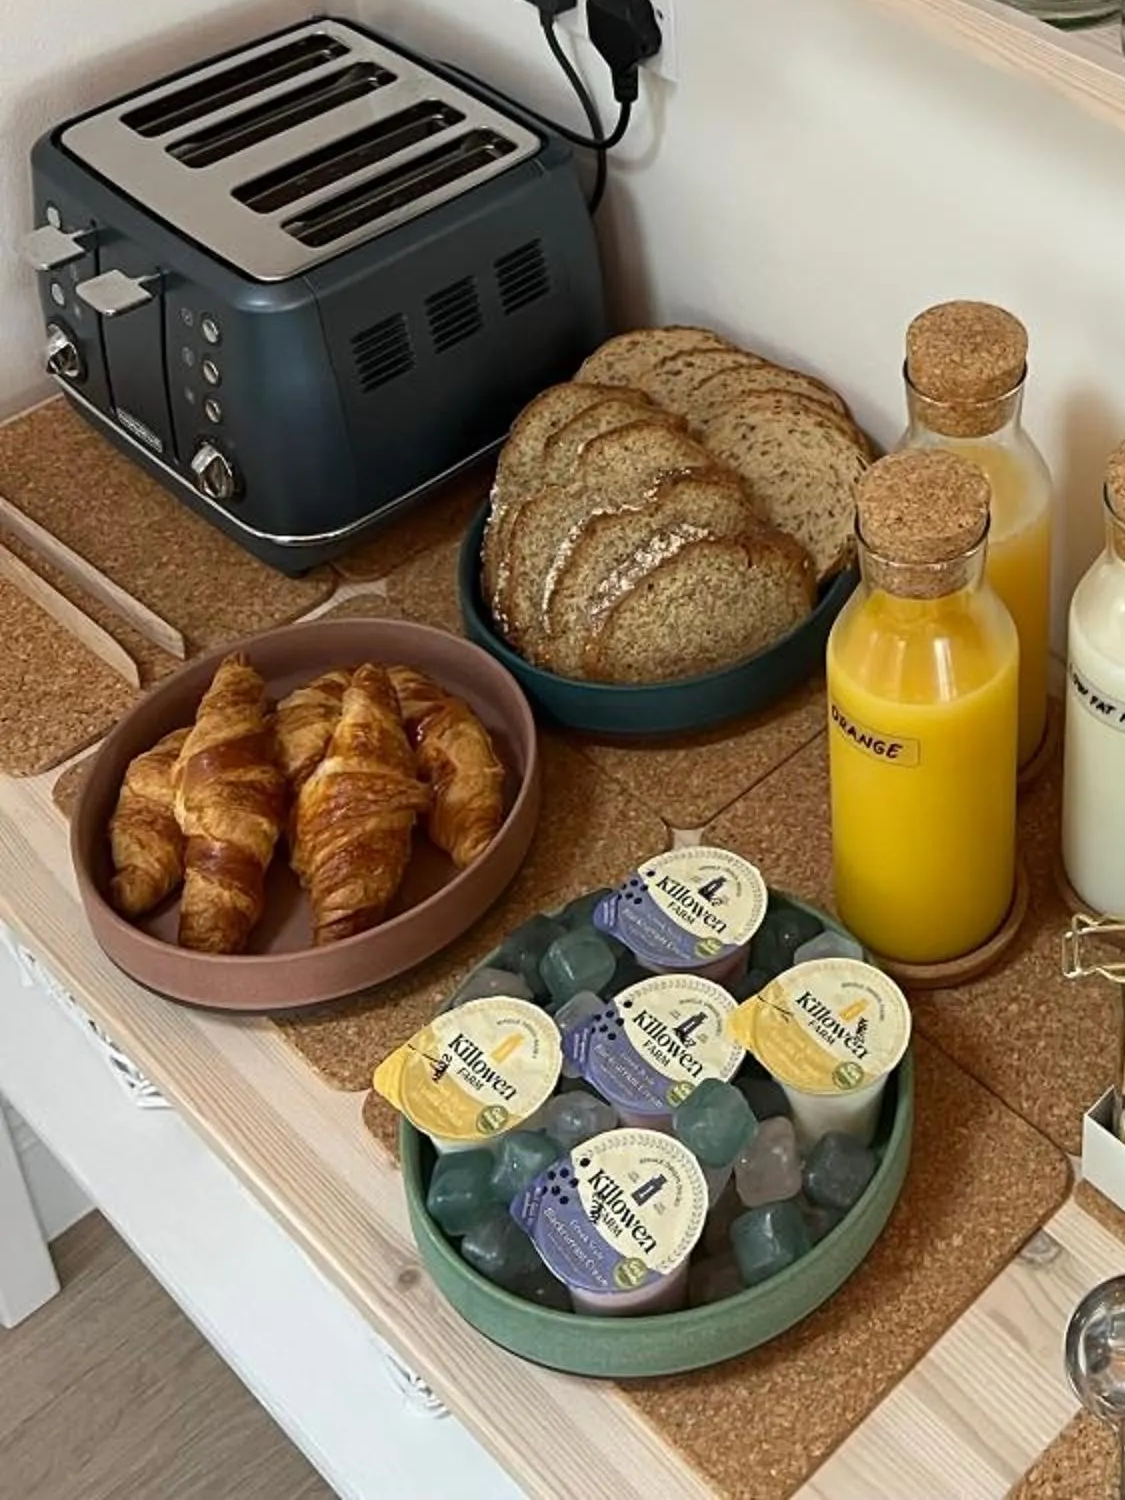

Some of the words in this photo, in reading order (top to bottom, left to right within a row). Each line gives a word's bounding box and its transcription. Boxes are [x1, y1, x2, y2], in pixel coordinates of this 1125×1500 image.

[831, 705, 903, 759] ORANGE
[1090, 695, 1116, 715] FAT
[655, 875, 727, 934] Killowen
[667, 900, 696, 926] FARM
[633, 1009, 704, 1078] Killowen
[795, 991, 870, 1061] Killowen
[807, 1019, 837, 1047] FARM
[447, 1033, 518, 1102] Killowen
[456, 1066, 487, 1093] FARM
[642, 1039, 671, 1068] FARM
[587, 1168, 657, 1255] Killowen
